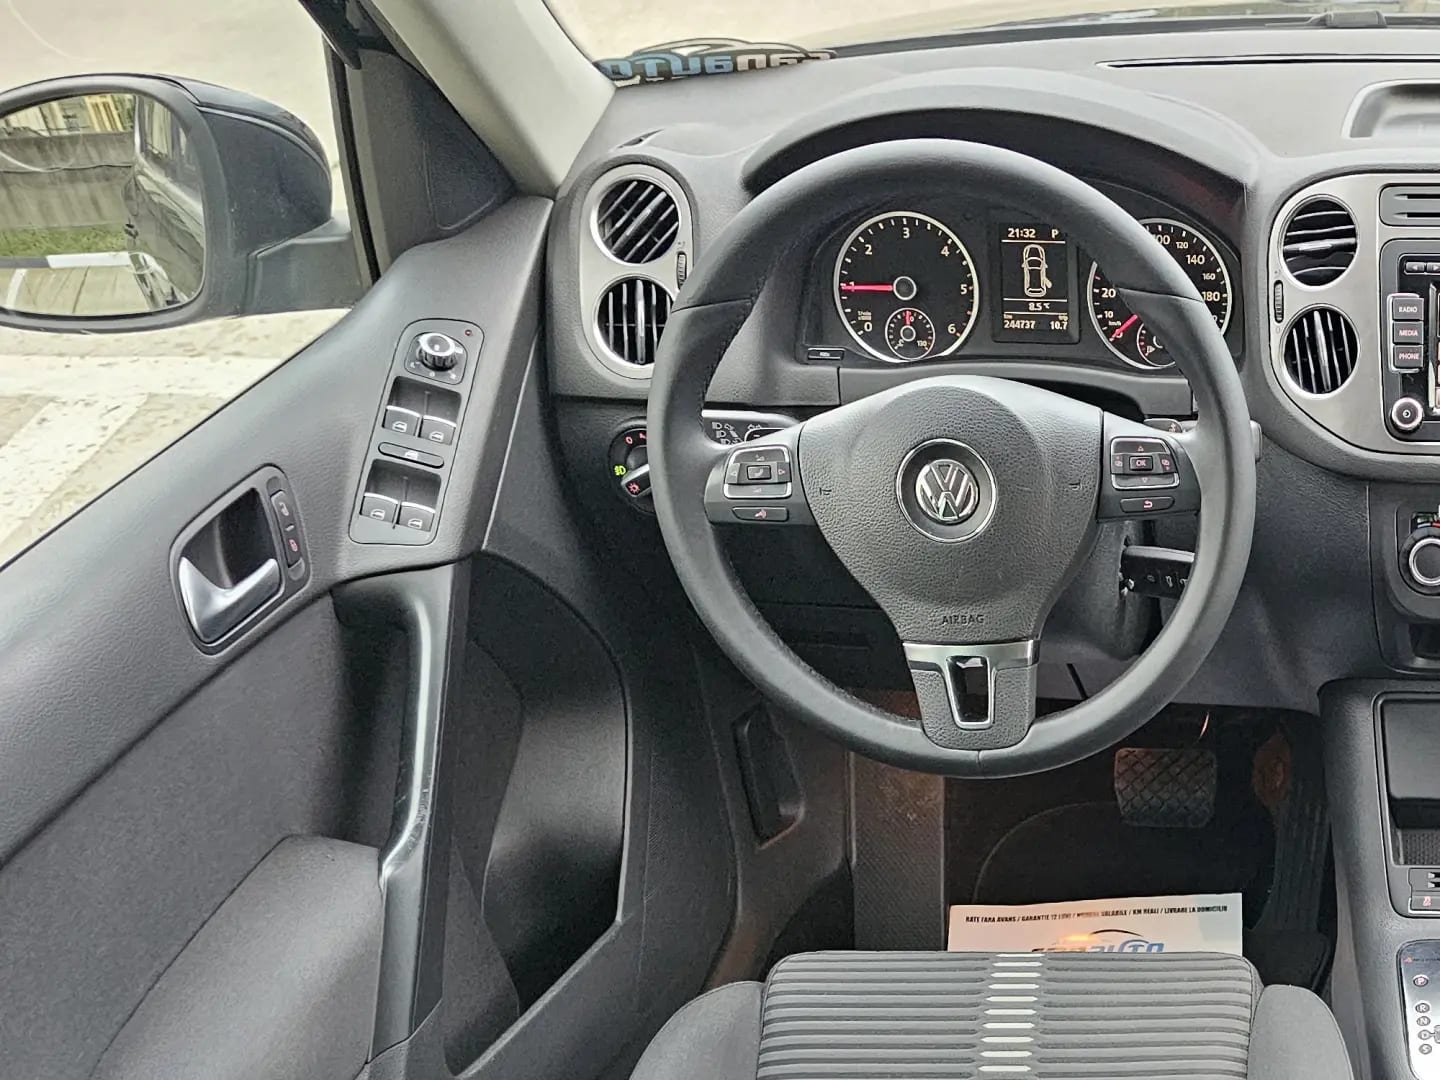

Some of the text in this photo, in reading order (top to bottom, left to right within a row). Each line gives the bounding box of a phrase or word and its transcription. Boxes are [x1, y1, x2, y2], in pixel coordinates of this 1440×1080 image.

[903, 227, 910, 239] 3
[1007, 228, 1059, 239] 21:32 P
[865, 244, 873, 255] 2
[1175, 241, 1189, 249] 120
[941, 245, 950, 257] 4
[1186, 254, 1205, 265] 140
[960, 284, 968, 295] 5
[1101, 288, 1116, 298] 20
[1201, 291, 1220, 301] 180
[1028, 302, 1042, 311] 8.5
[864, 321, 873, 332] 0
[947, 323, 956, 334] 6
[1003, 320, 1036, 329] 244737
[1050, 321, 1068, 330] 10.7
[1399, 352, 1420, 360] PHONE
[1135, 459, 1146, 467] OK
[940, 614, 985, 625] AIRBAG
